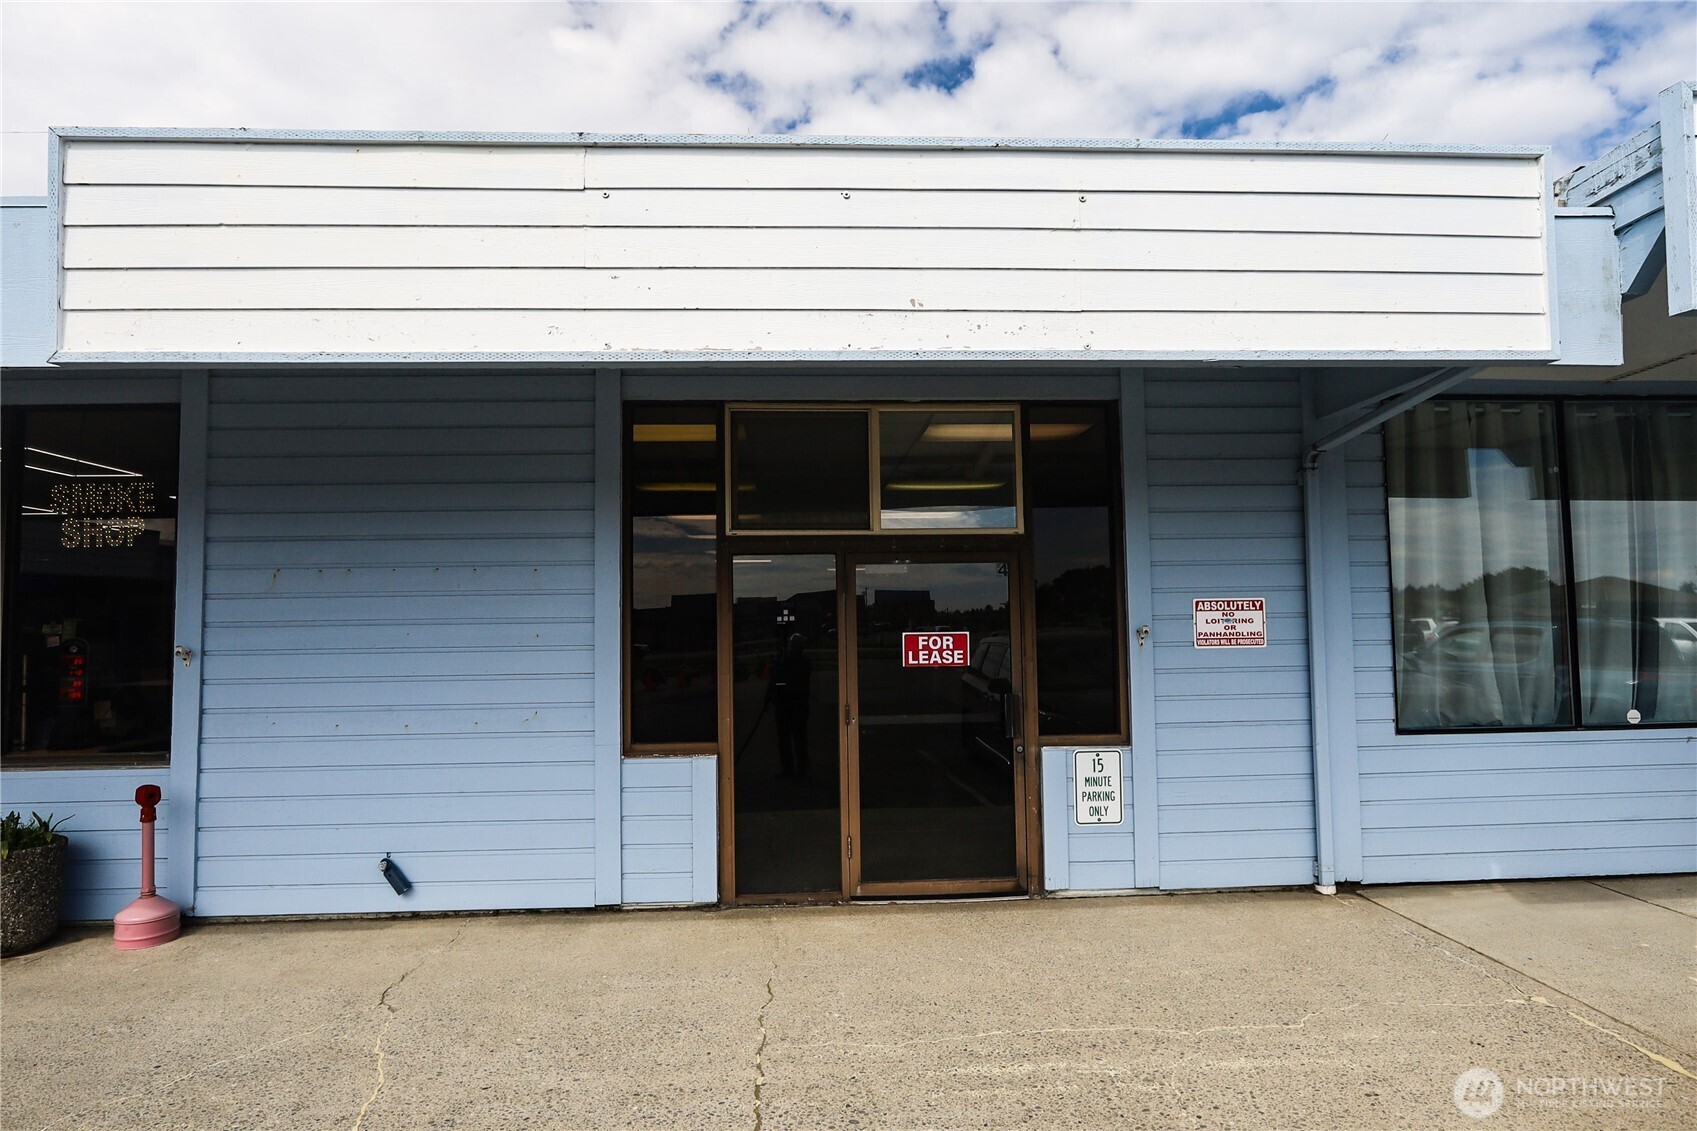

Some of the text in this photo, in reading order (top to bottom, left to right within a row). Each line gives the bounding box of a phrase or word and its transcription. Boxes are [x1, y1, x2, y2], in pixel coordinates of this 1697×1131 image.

[50, 482, 155, 514] SMOKE
[61, 516, 145, 548] SHOP
[1197, 601, 1262, 611] ABSOLUTELY
[918, 635, 954, 650] FOR
[908, 650, 964, 665] LEASE
[1092, 758, 1104, 773] 15
[1084, 776, 1112, 787] MINUTE
[1081, 791, 1116, 802] PARKING
[1088, 805, 1109, 817] ONLY
